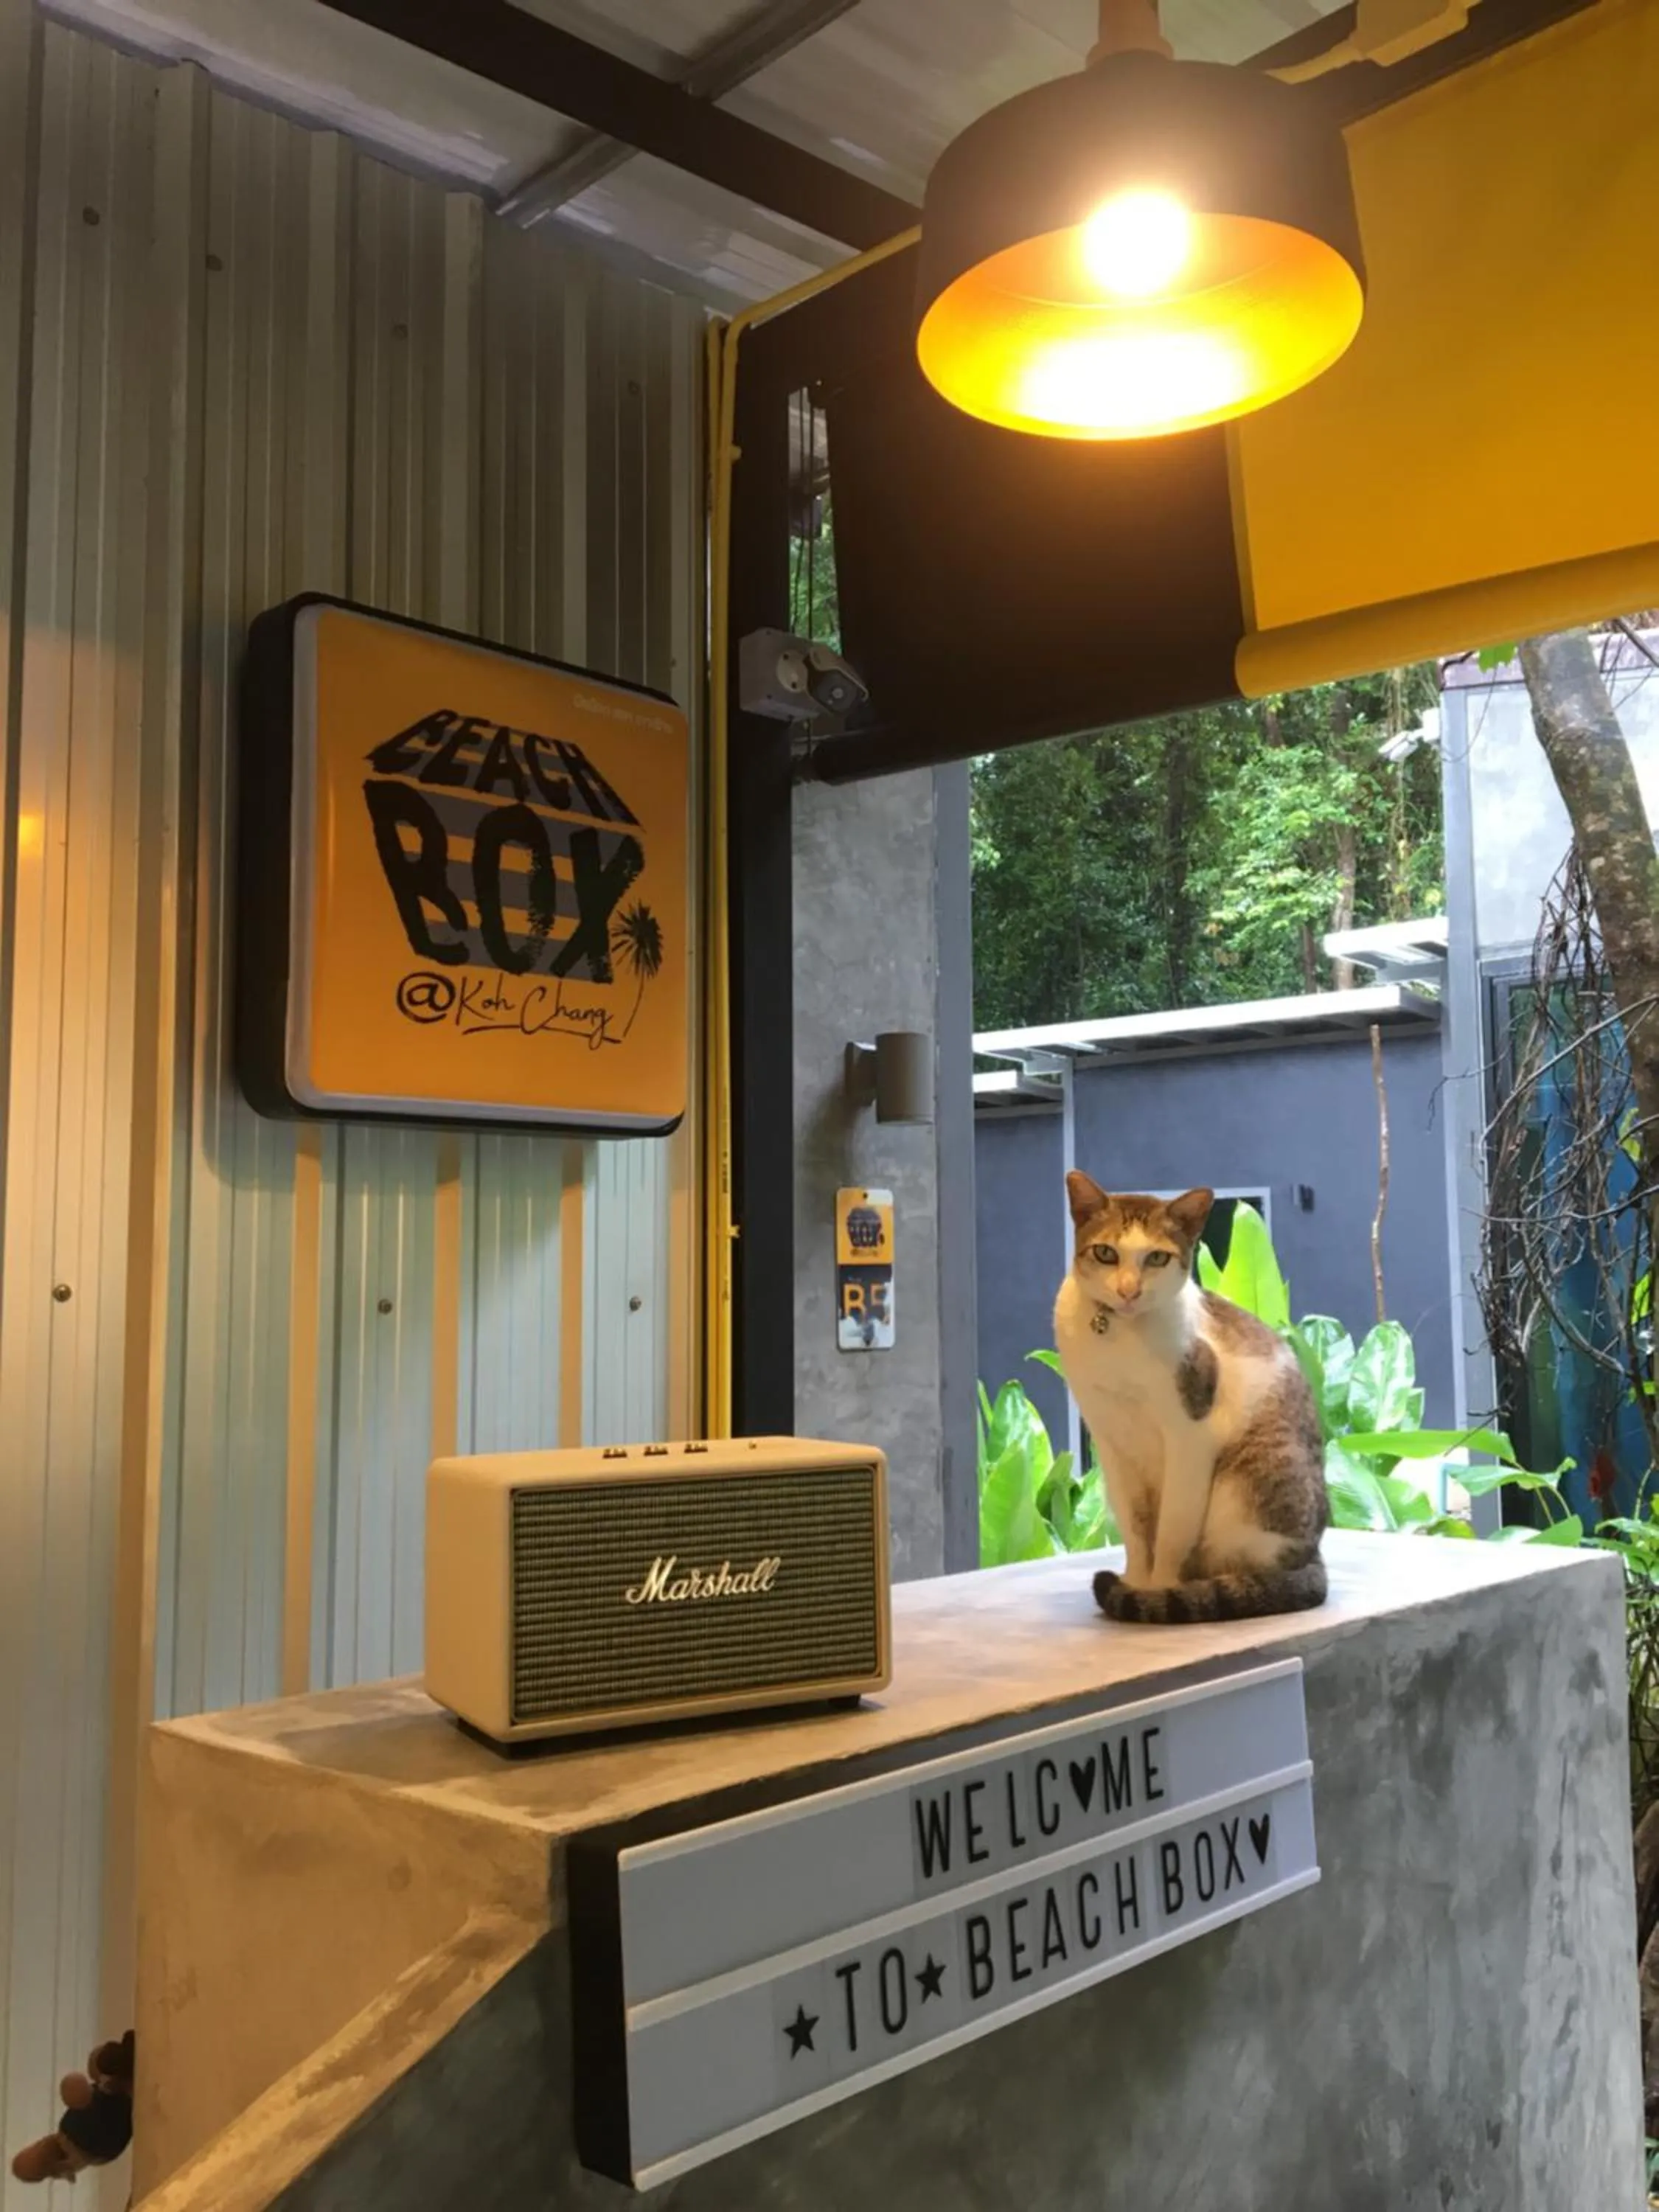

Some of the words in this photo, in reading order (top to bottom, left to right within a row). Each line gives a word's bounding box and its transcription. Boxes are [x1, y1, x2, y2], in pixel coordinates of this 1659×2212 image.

[364, 709, 646, 829] BEACH
[364, 779, 646, 984] BOX
[520, 980, 614, 1051] Chang
[626, 1556, 782, 1604] Marshall
[835, 1947, 908, 2053] TO
[965, 1854, 1141, 2001] BEACH
[1161, 1816, 1245, 1916] BOX
